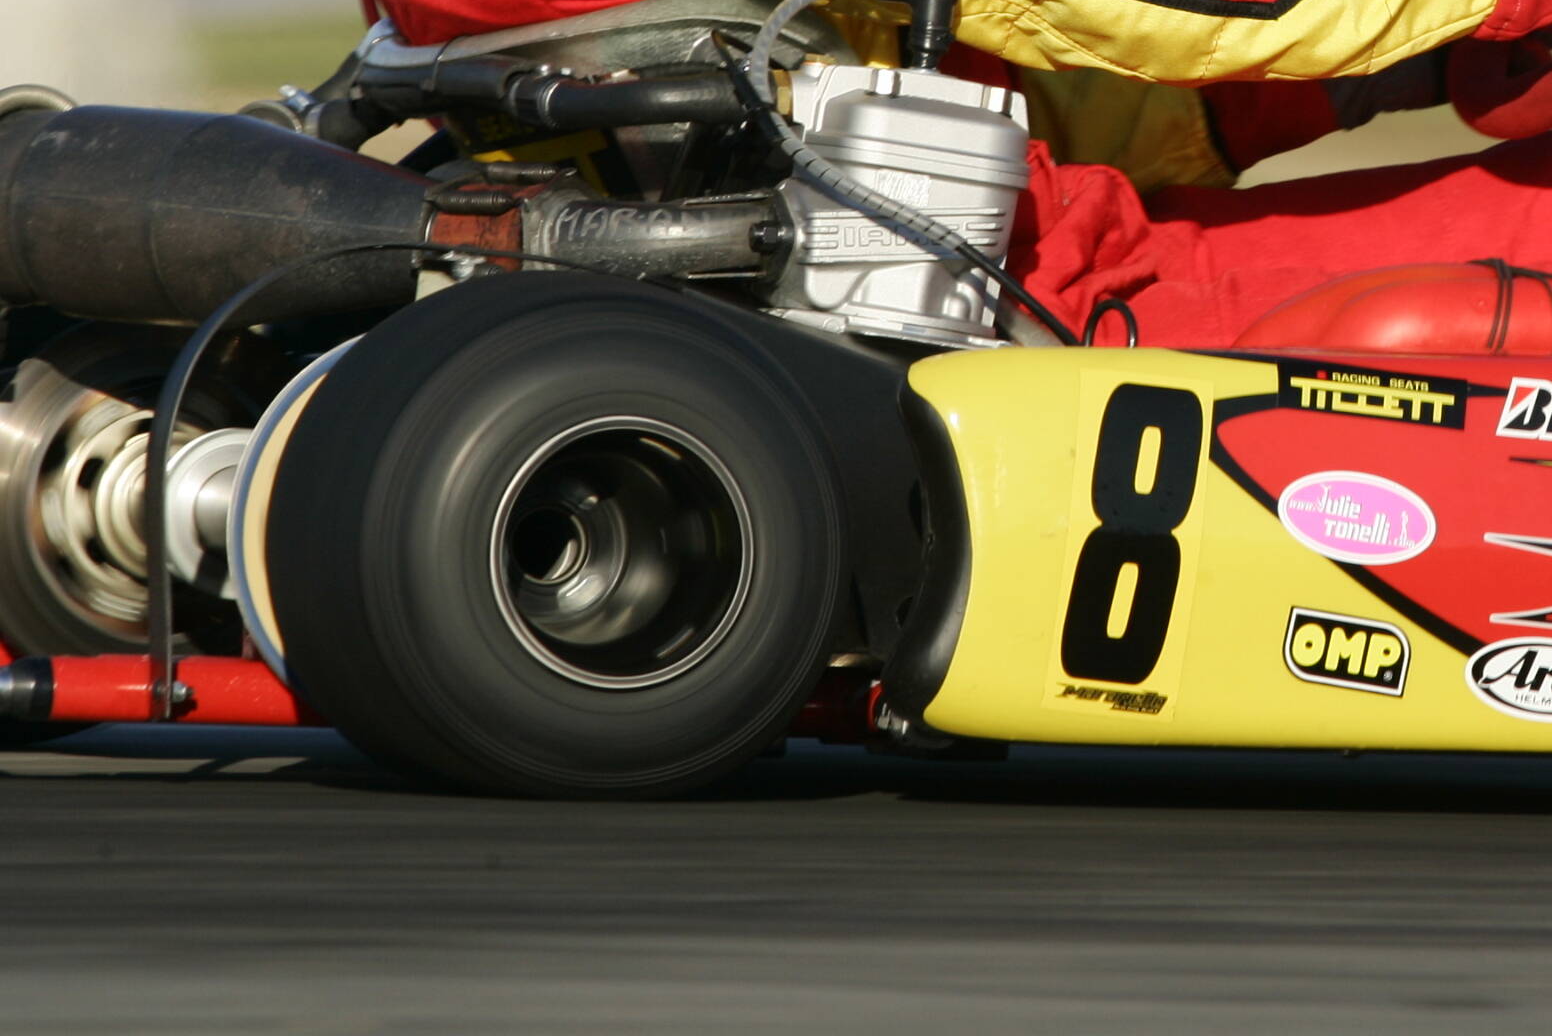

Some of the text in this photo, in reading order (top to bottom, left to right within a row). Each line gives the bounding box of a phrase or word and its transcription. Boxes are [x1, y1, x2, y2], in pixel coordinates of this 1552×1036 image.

[1332, 371, 1380, 386] RACING
[1060, 382, 1204, 685] 8
[1291, 622, 1402, 678] OMP
